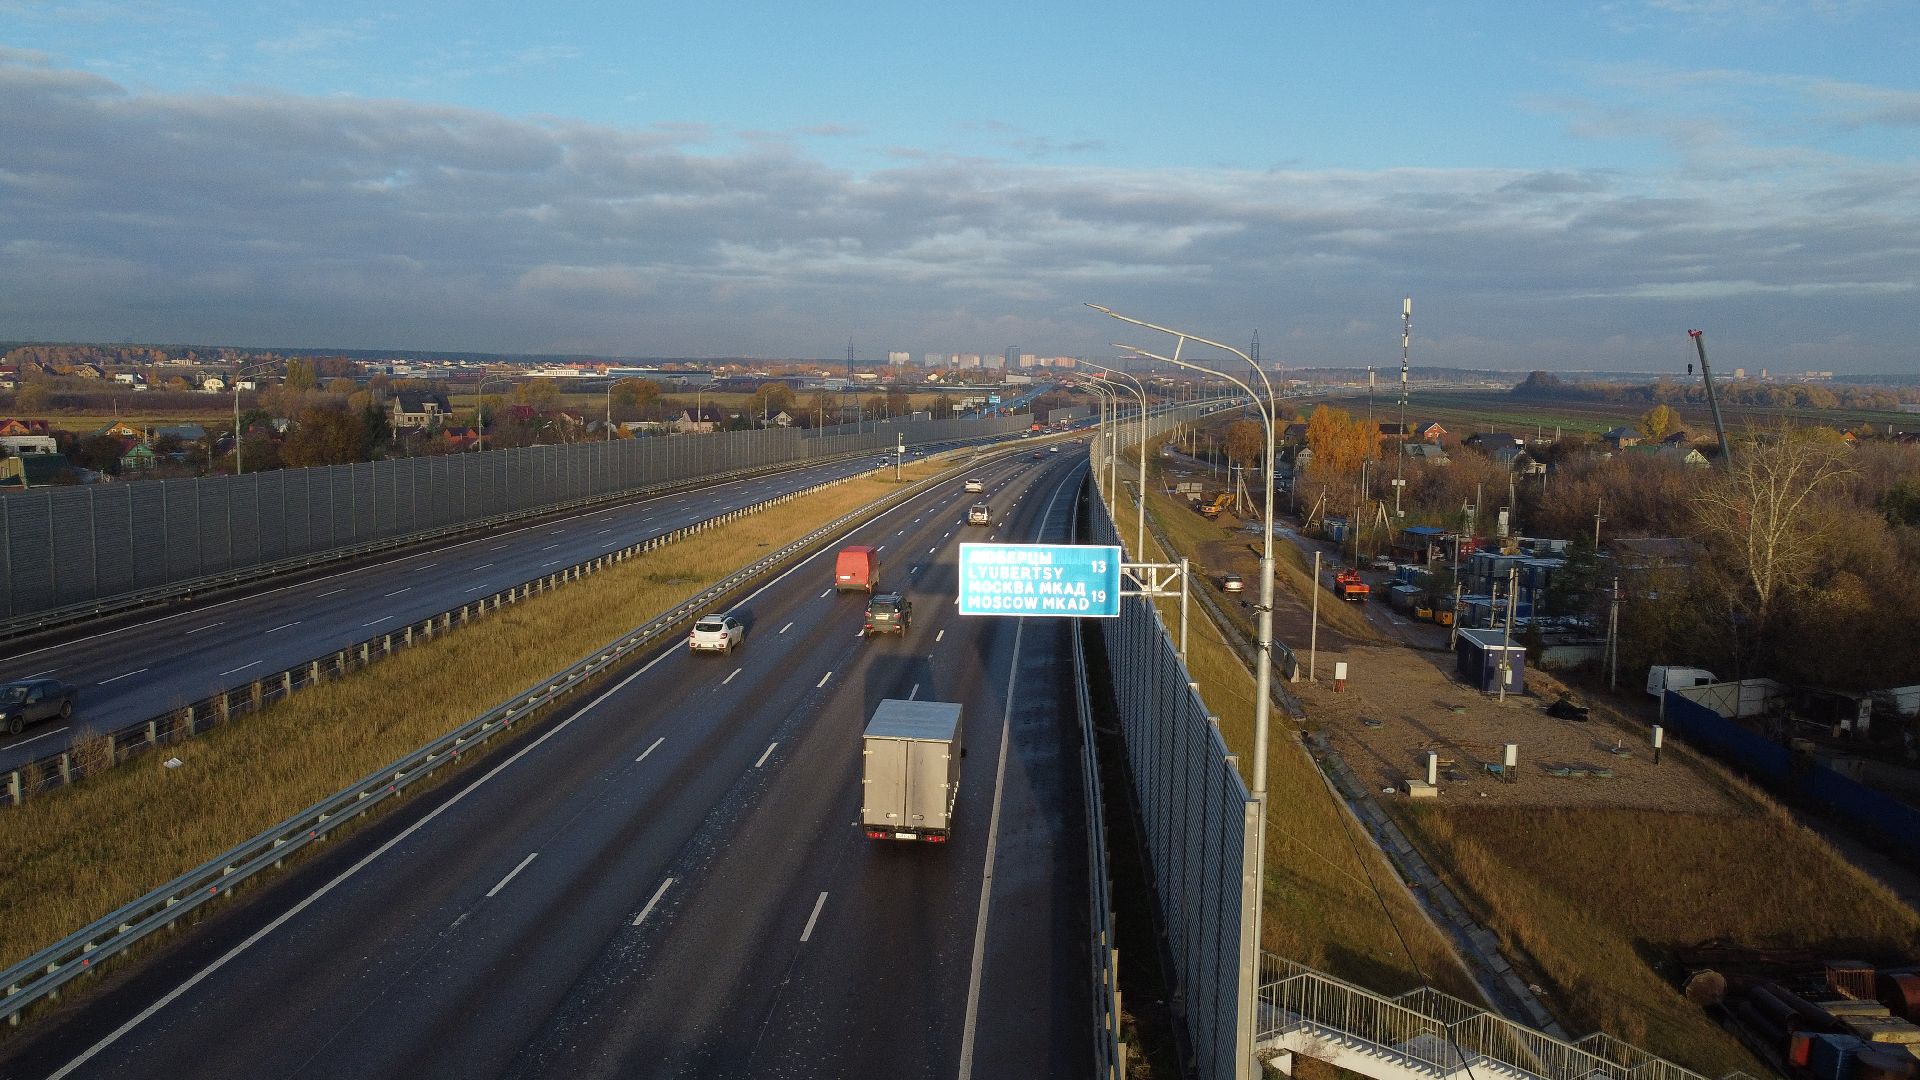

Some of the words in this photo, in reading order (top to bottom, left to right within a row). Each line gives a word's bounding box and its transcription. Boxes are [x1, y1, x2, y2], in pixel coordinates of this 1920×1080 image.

[968, 551, 1052, 565] БЕРЦЫ
[968, 566, 1064, 579] LYUBERTSY
[1092, 560, 1107, 574] 13
[968, 582, 1035, 595] МОСКВА
[1039, 582, 1086, 597] МКАД
[1091, 590, 1107, 603] 19
[968, 596, 1038, 610] MOSCOW
[1042, 597, 1090, 611] MKAD
